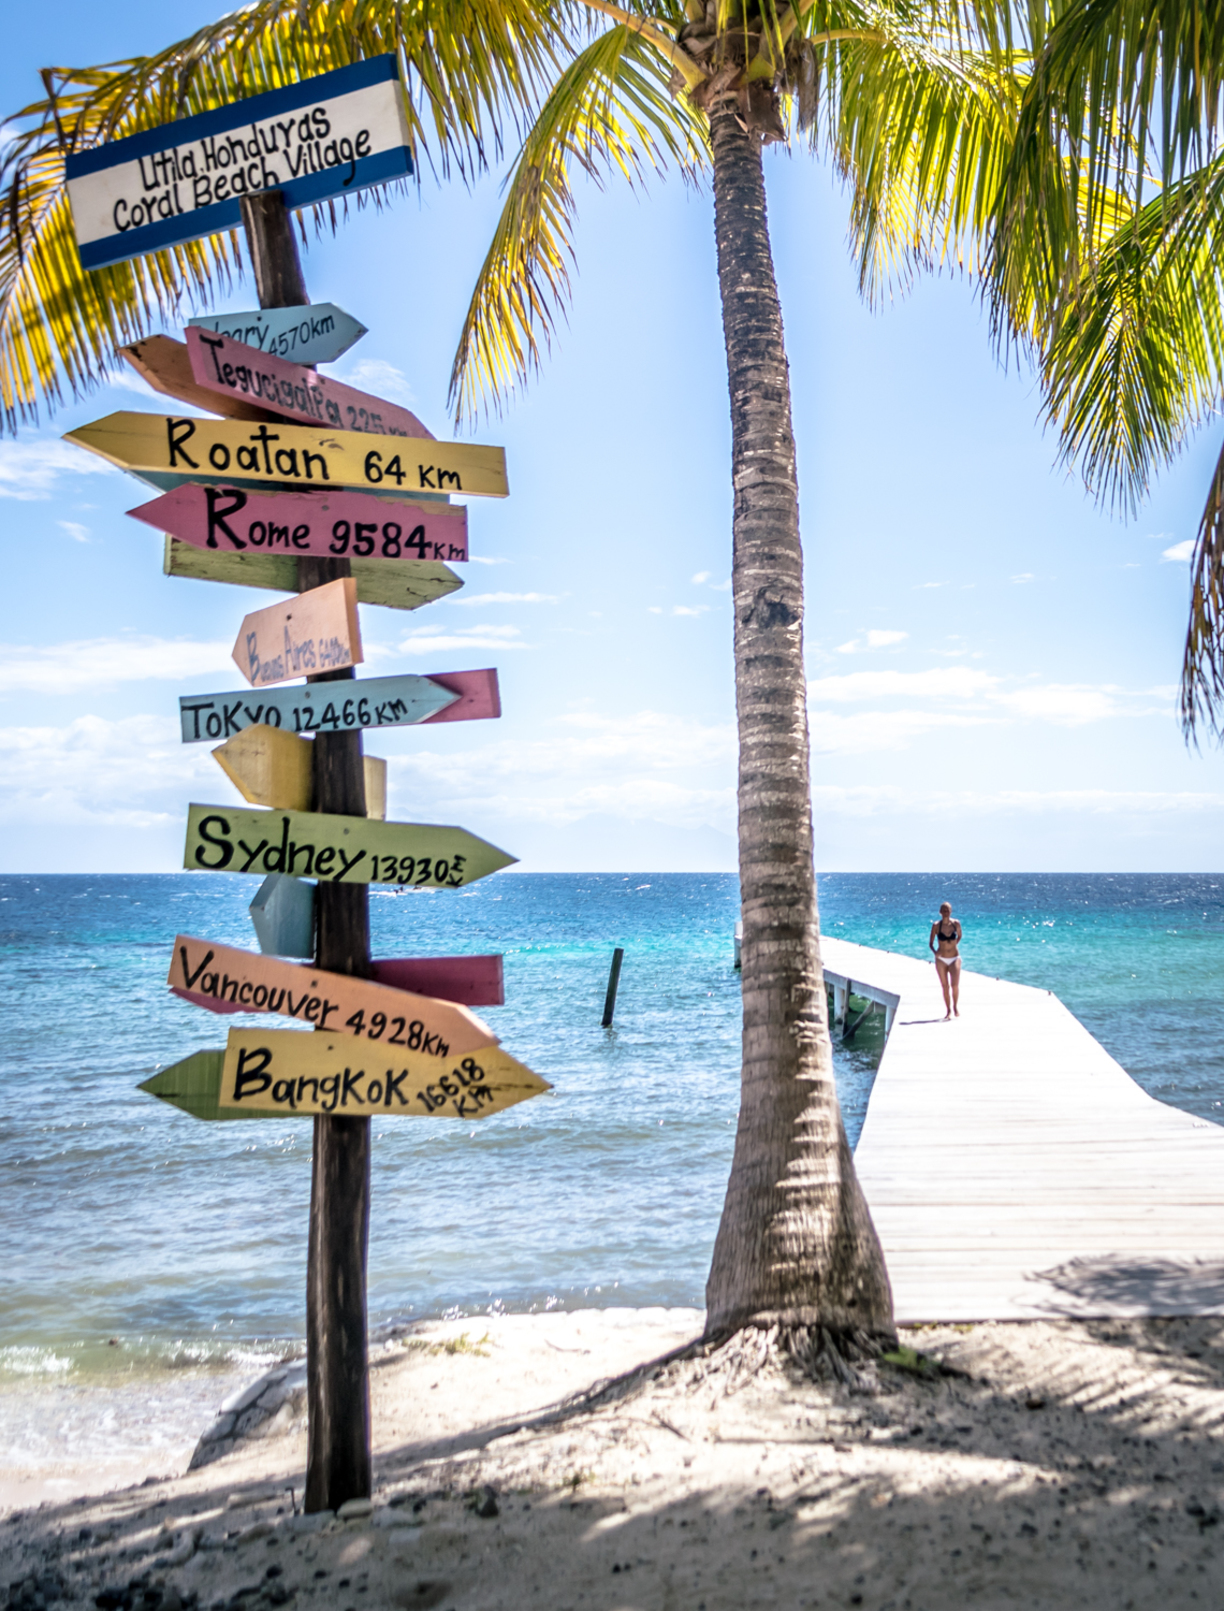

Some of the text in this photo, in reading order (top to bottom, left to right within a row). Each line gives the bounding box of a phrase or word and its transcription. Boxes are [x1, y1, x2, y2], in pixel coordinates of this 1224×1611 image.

[113, 129, 372, 232] Coral Beach Village
[166, 417, 330, 481] Roatan
[364, 451, 406, 485] 64
[204, 487, 310, 550] Rome
[194, 815, 366, 882] Sydney
[180, 946, 339, 1027] Vancouver
[416, 1057, 485, 1114] 16618
